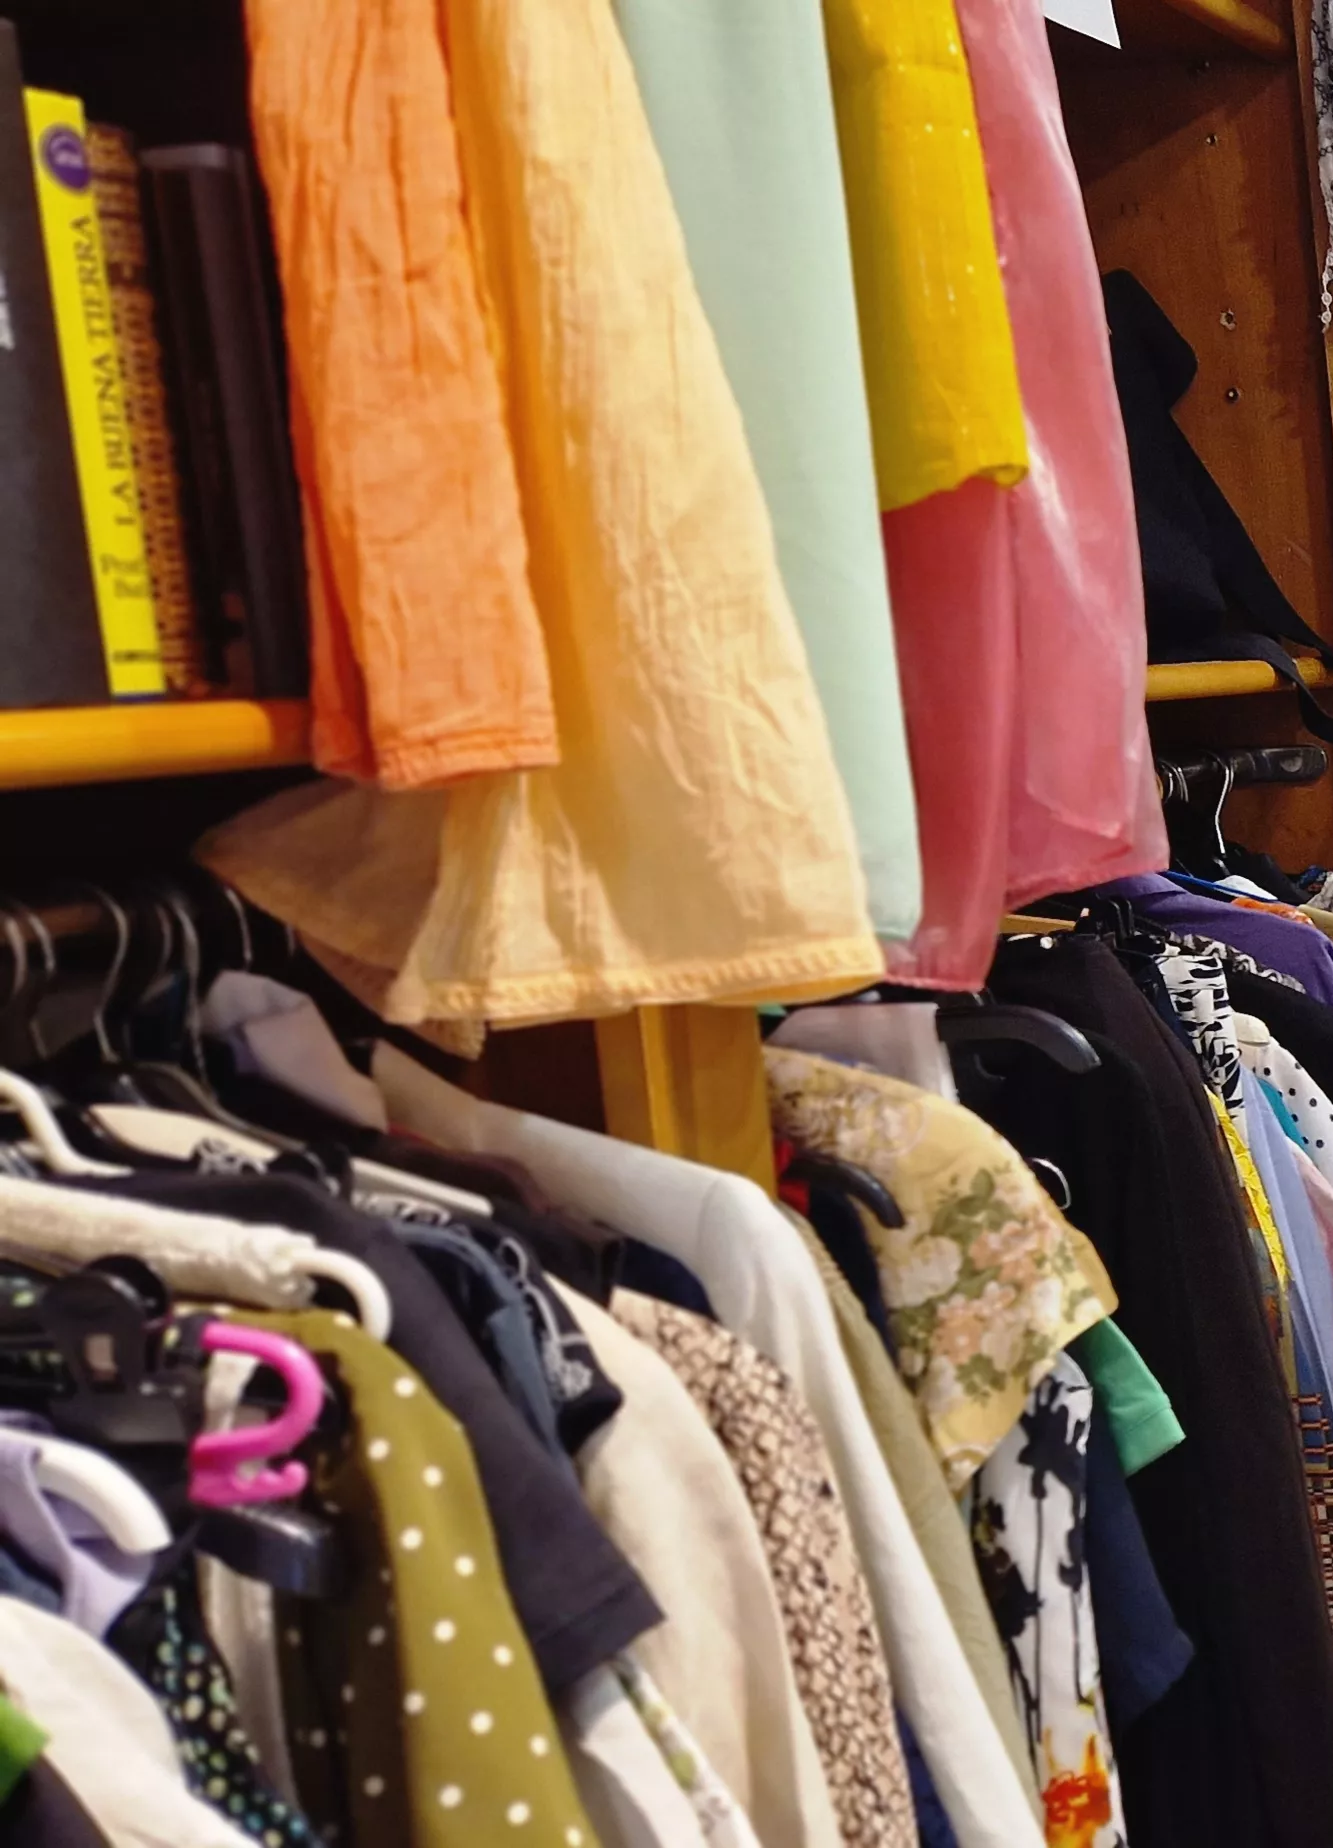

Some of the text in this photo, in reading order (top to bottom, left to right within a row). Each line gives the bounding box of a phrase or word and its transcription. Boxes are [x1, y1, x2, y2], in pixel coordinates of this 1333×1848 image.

[69, 214, 110, 343] TIERRA
[90, 350, 130, 471] BUENA
[109, 478, 136, 526] LA
